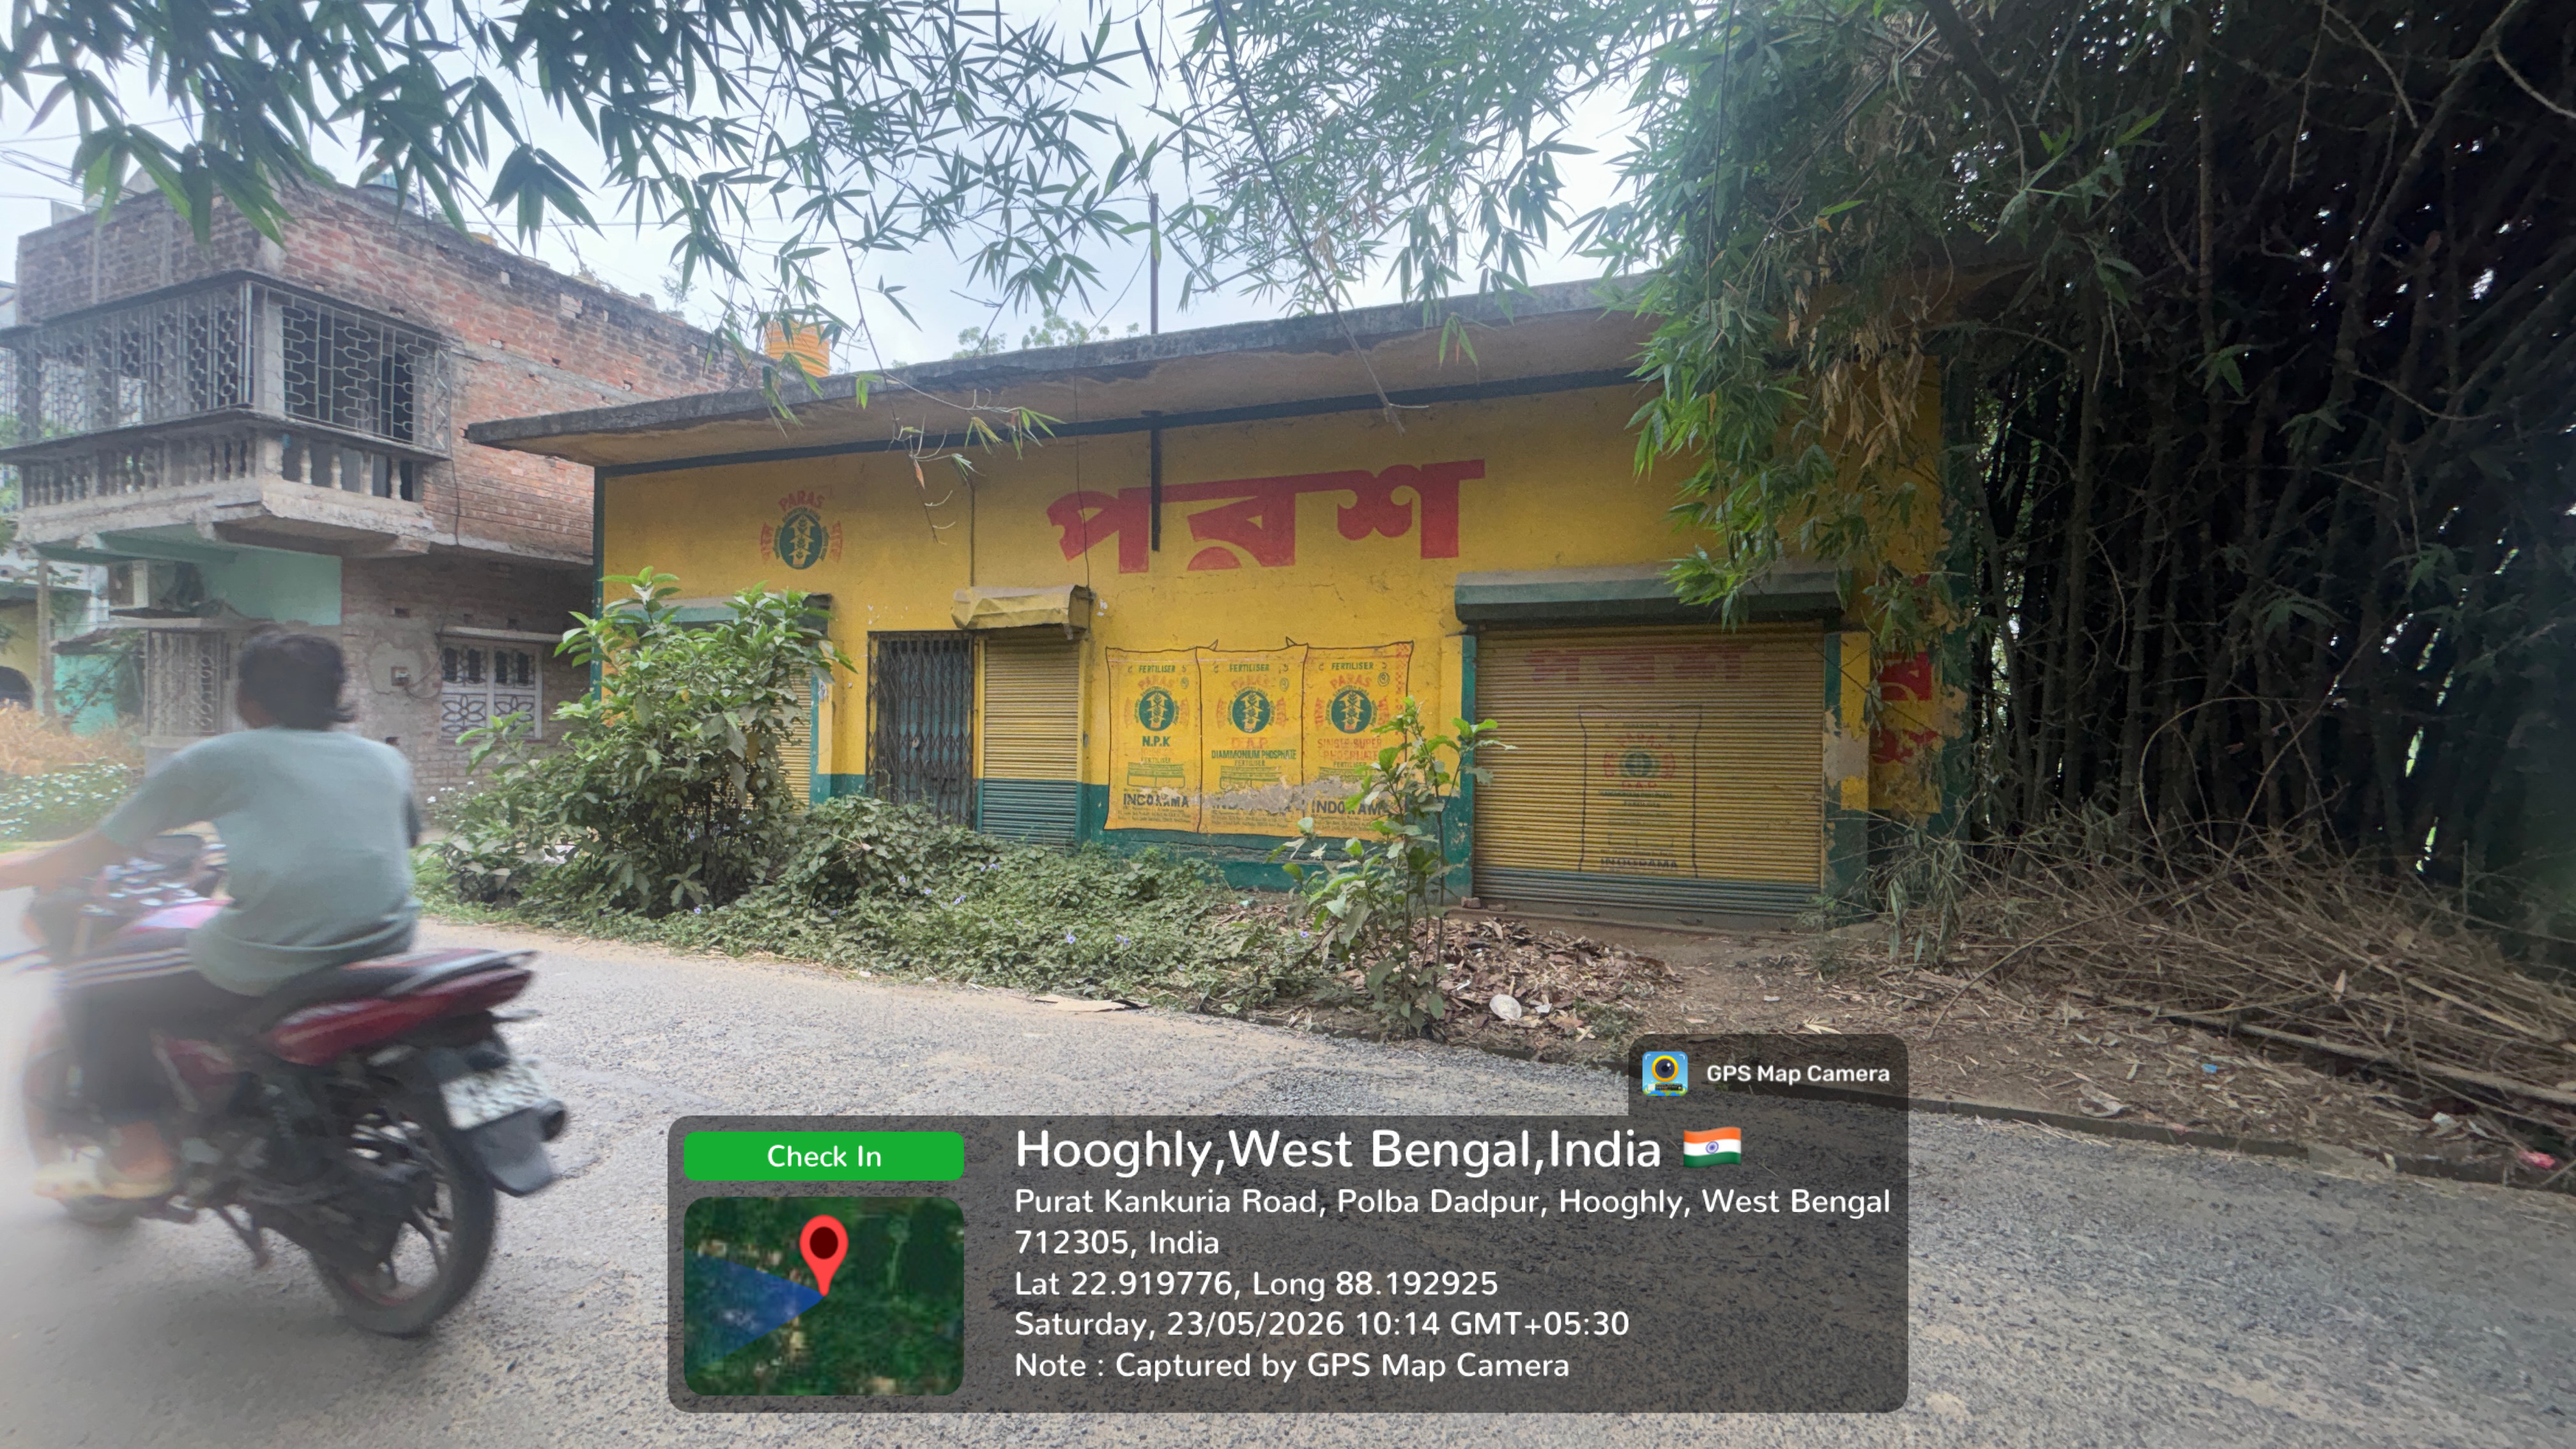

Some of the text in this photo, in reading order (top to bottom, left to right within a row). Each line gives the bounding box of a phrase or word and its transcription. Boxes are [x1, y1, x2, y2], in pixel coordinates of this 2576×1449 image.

[778, 490, 825, 512] PARAS
[1046, 459, 1485, 573] পরশ
[1230, 664, 1269, 672] FERTILISER
[1331, 662, 1374, 670] FERTILISER
[1142, 736, 1170, 747] N.P.K
[1211, 749, 1260, 759] DIAMMONIUM
[1311, 799, 1381, 816] INDOAM
